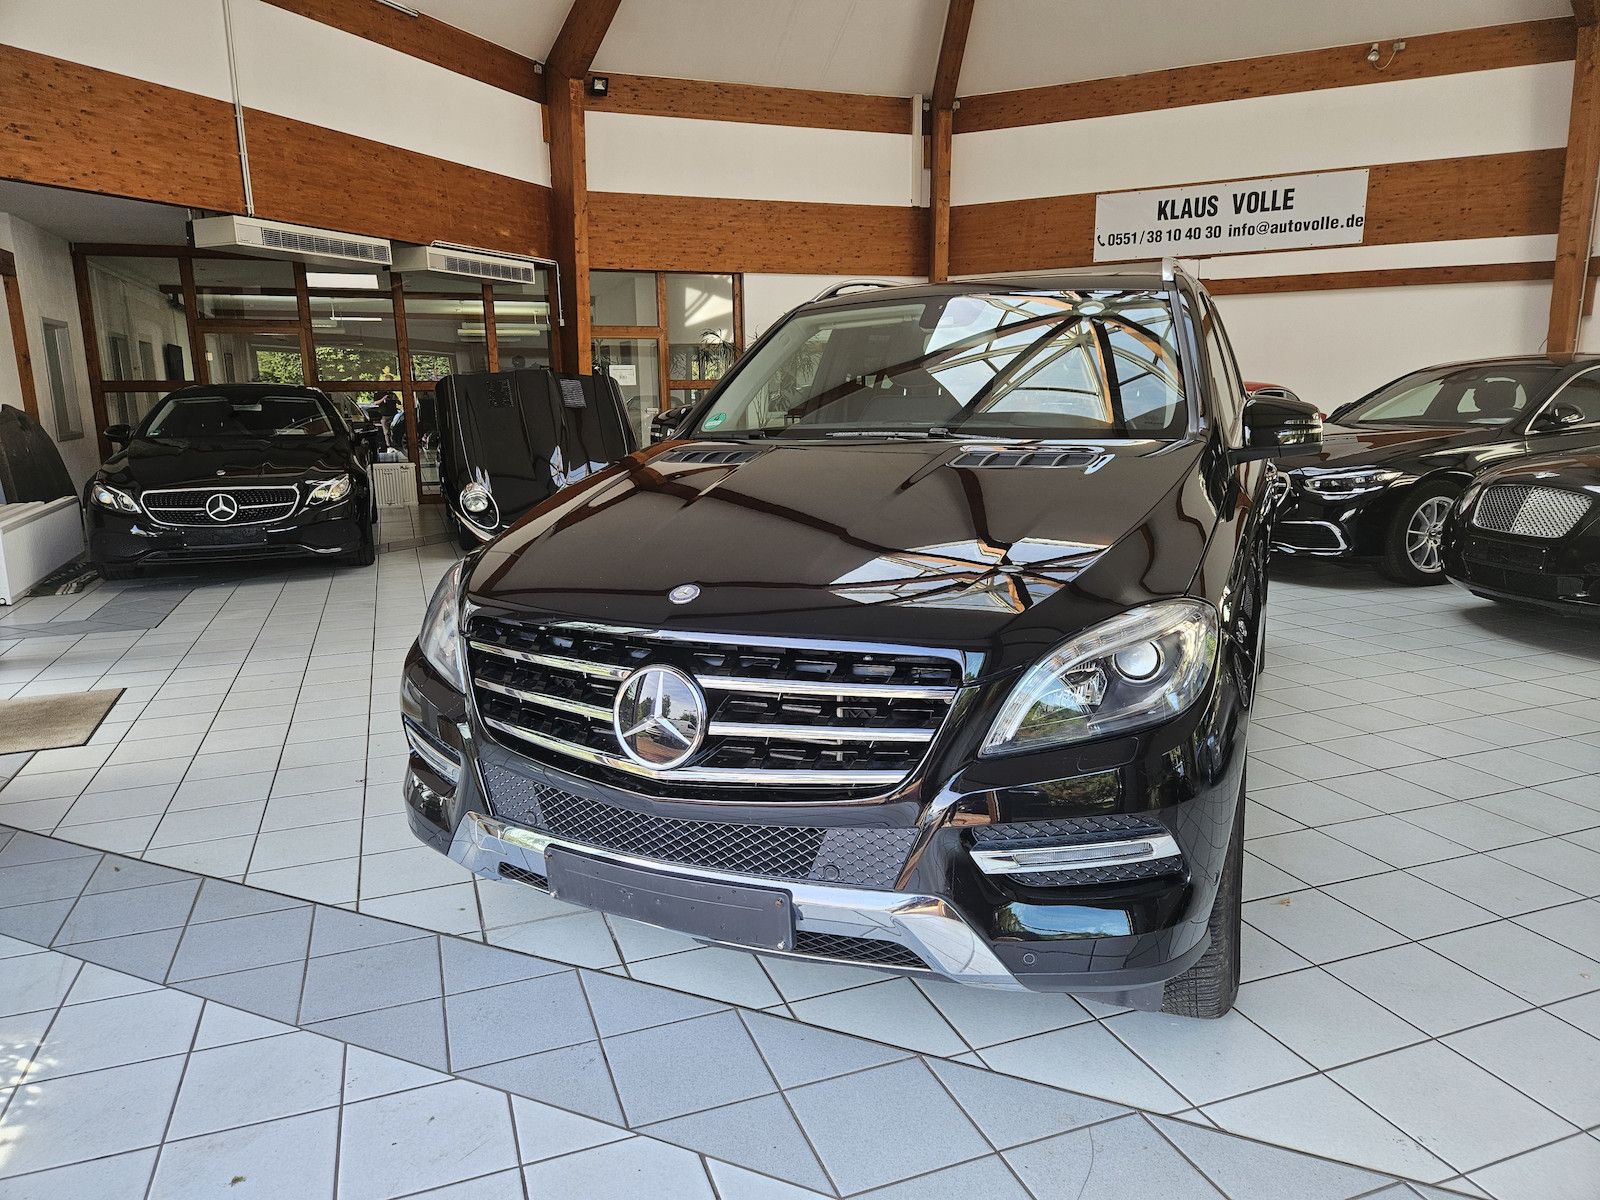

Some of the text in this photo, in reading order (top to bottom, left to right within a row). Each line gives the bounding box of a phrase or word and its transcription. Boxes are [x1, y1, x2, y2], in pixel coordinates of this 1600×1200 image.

[1157, 188, 1295, 221] KLAUS VOLLE
[1166, 228, 1182, 242] 10
[1185, 226, 1202, 240] 40
[1205, 225, 1222, 239] 30
[1228, 214, 1364, 237] info@autovolle.de
